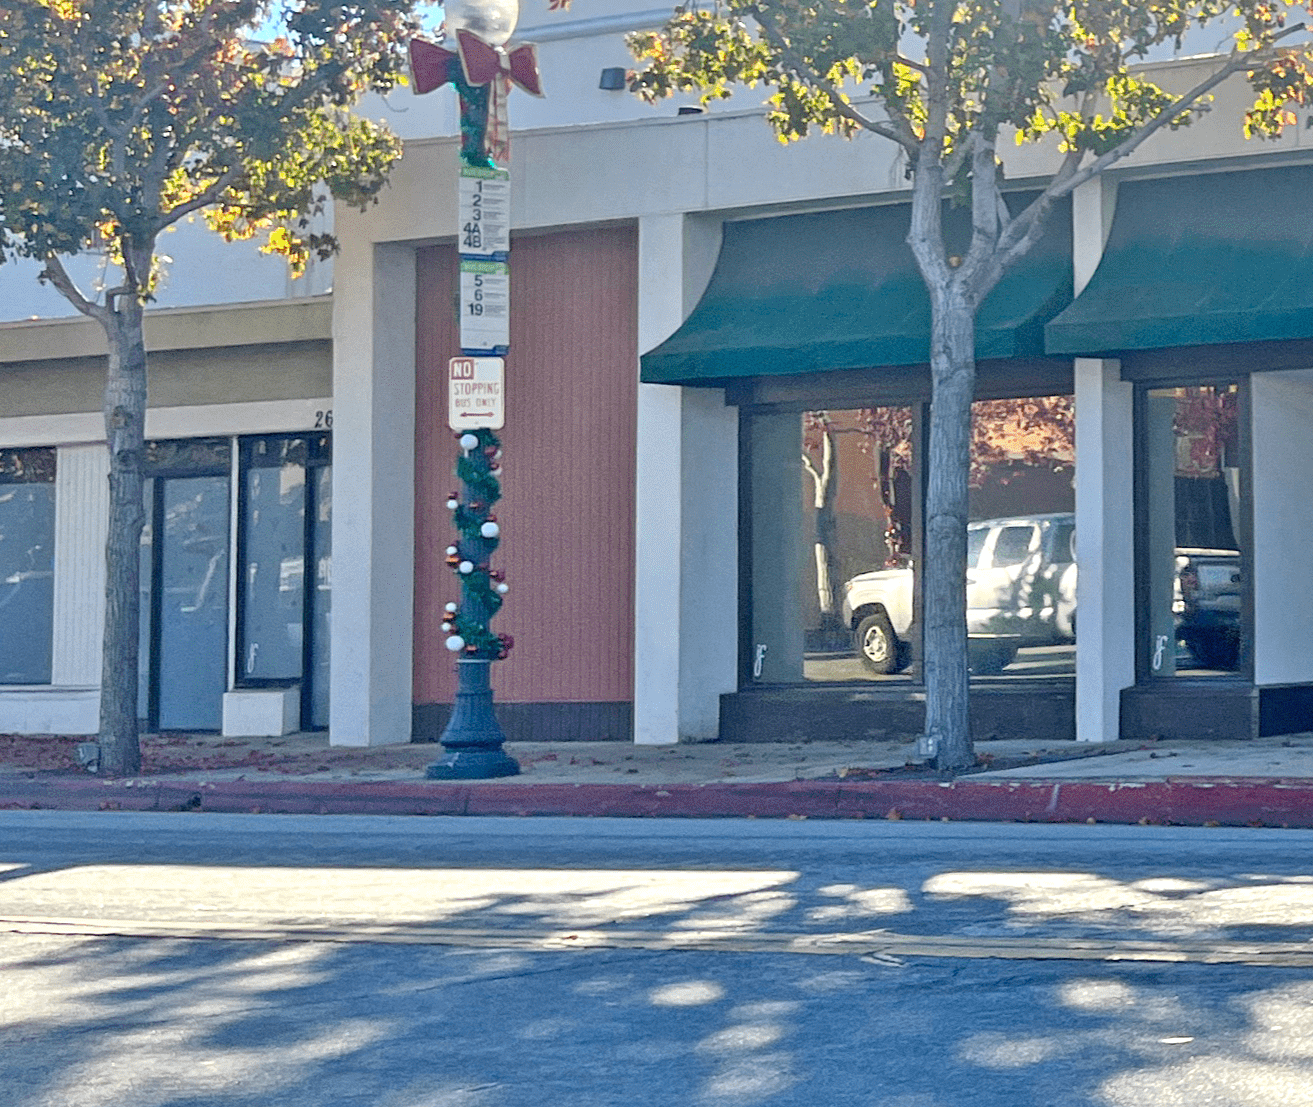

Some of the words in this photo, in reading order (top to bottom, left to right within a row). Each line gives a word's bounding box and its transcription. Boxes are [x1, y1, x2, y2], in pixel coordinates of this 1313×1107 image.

[475, 180, 483, 193] 1
[472, 194, 482, 207] 2
[472, 208, 482, 221] 3
[463, 222, 482, 235] 4A
[463, 235, 482, 248] 4B
[474, 274, 483, 287] 5
[474, 288, 483, 302] 6
[467, 303, 484, 316] 19
[453, 361, 472, 378] NO
[453, 382, 500, 396] STOPPING
[455, 397, 471, 408] BUS
[475, 397, 496, 408] ONLY
